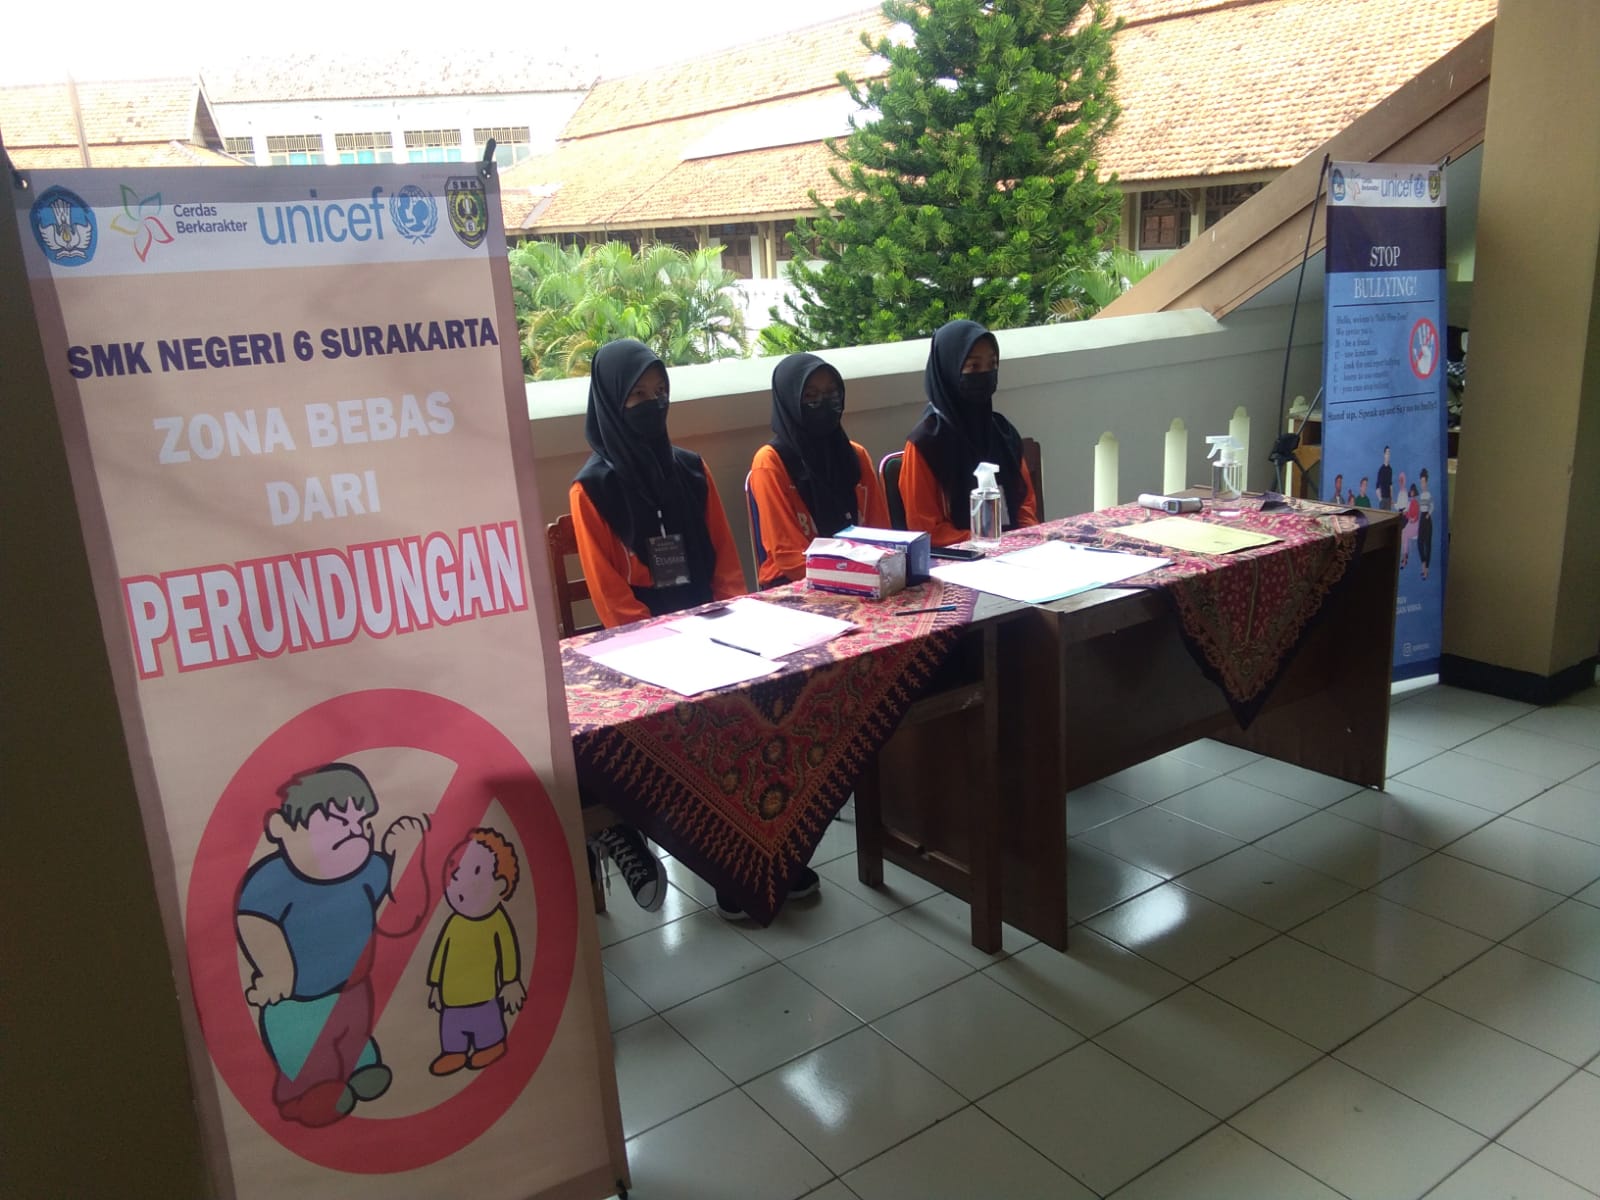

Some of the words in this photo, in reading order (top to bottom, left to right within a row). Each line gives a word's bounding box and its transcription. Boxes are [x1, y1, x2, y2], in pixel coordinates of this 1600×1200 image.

[452, 181, 477, 189] SMK
[1381, 173, 1414, 197] unicef
[173, 203, 217, 217] Cerdas
[175, 219, 248, 234] Berkarakter
[257, 186, 385, 245] unicef
[1369, 246, 1401, 268] STOP
[68, 341, 152, 379] SMK
[158, 332, 286, 371] NEGERI
[294, 330, 314, 361] 6
[321, 317, 499, 359] SURAKARTA
[153, 407, 296, 465] ZONA
[305, 391, 455, 448] BEBAS
[266, 470, 381, 526] DARI
[121, 520, 529, 680] PERUNDUNGAN
